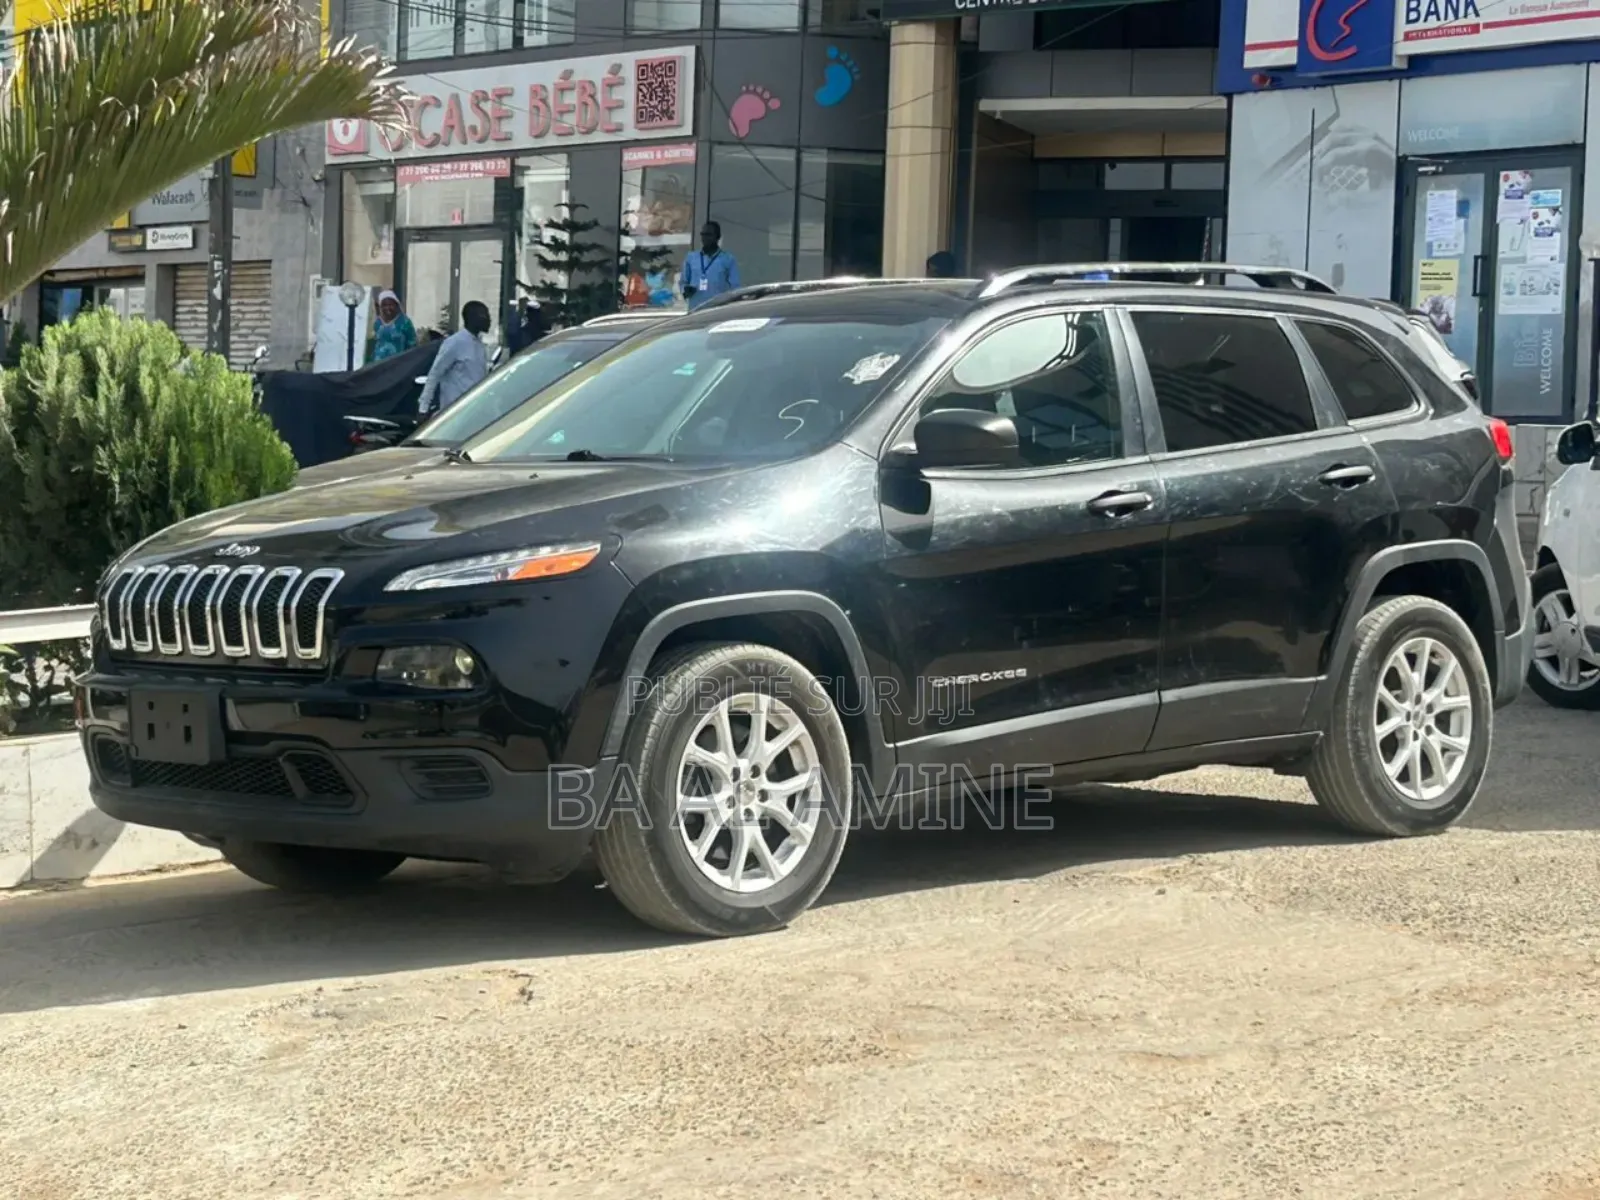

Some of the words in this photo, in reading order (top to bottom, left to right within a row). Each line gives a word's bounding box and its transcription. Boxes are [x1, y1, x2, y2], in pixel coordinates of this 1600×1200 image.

[1405, 0, 1481, 25] BANK
[528, 62, 626, 138] BÉBÉ
[1540, 327, 1553, 395] WELCOME
[214, 542, 261, 558] Jeep
[931, 668, 1028, 688] CHEROKEE
